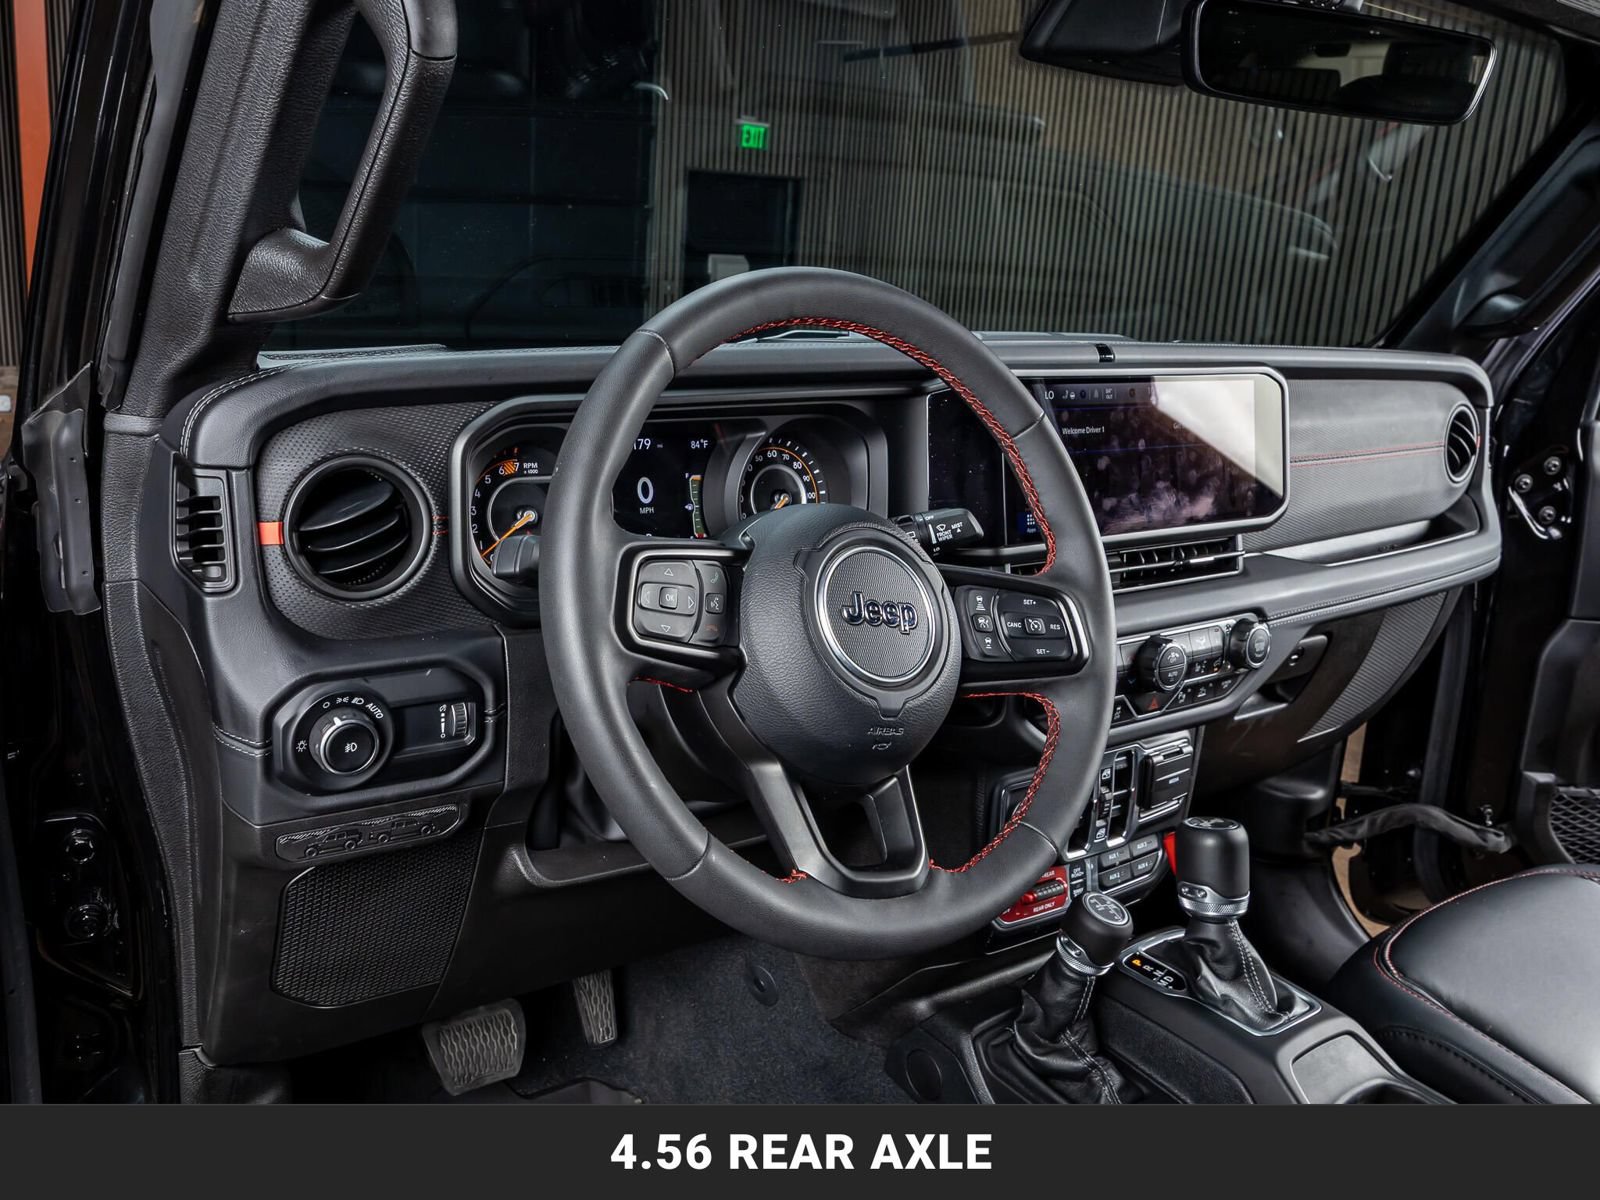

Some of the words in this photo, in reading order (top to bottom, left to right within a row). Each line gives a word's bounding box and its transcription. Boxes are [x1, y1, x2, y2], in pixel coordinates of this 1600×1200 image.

[1044, 391, 1055, 400] LO
[1062, 427, 1085, 435] Welcome
[690, 438, 709, 449] 84°F
[767, 450, 778, 458] 60
[498, 465, 505, 475] 6
[514, 462, 520, 472] 7
[793, 461, 802, 469] 80
[484, 474, 492, 484] 5
[474, 489, 481, 499] 4
[637, 476, 654, 504] 0
[470, 505, 477, 516] 3
[639, 506, 655, 514] MPH
[472, 524, 479, 534] 2
[951, 521, 963, 530] MIST
[665, 593, 675, 602] OK
[840, 591, 918, 635] Jeep
[366, 702, 384, 719] AUTO
